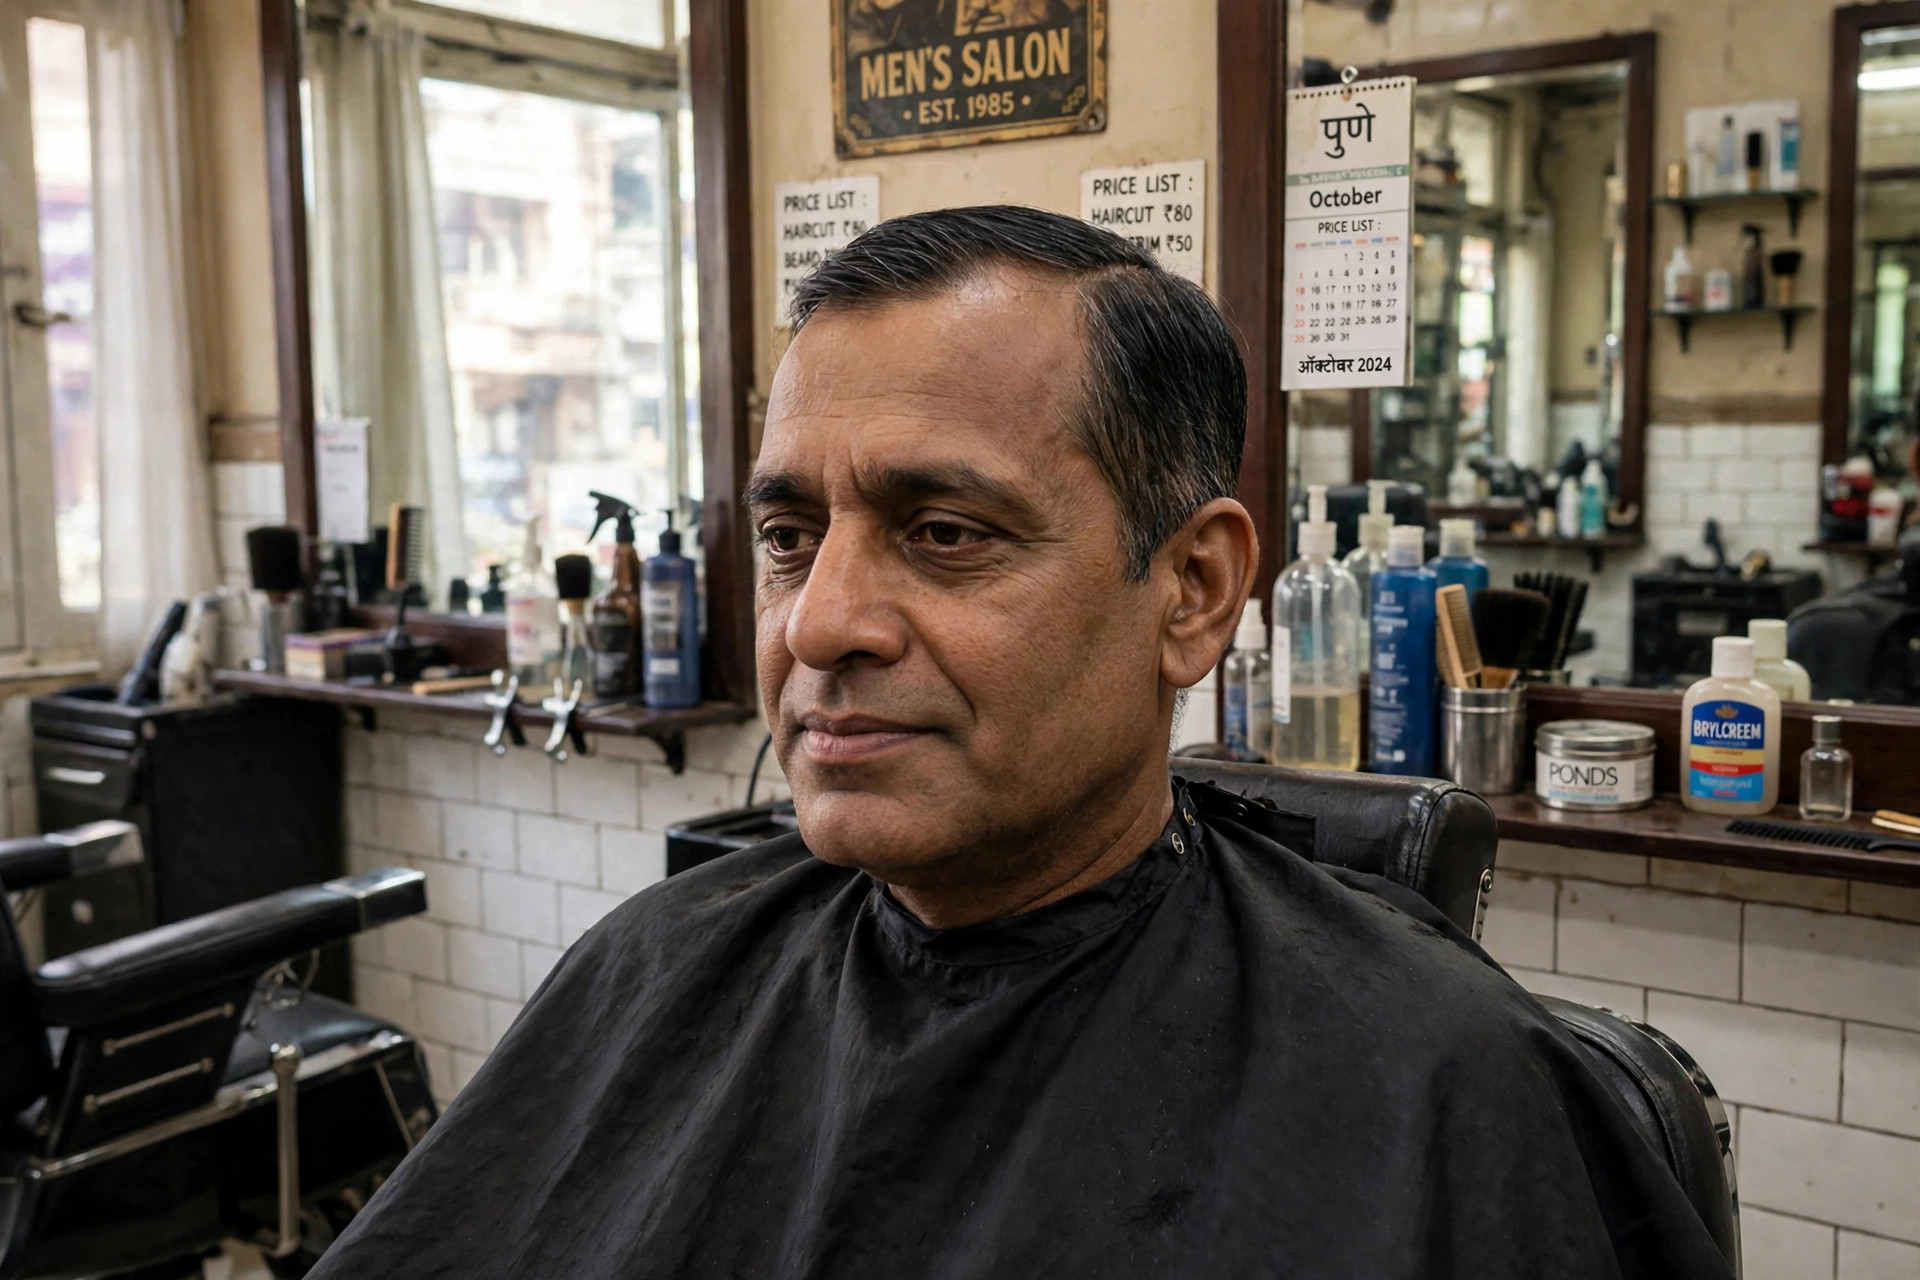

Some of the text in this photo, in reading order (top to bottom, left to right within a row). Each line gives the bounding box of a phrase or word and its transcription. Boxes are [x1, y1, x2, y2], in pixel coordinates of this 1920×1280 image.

[860, 28, 1070, 100] MEN'S SALON
[918, 91, 1015, 124] EST. 1985
[1320, 103, 1376, 159] पुणे
[1093, 176, 1137, 196] PRICE
[1146, 173, 1180, 193] LIST
[783, 193, 819, 213] PRICE
[827, 190, 855, 209] LIST
[1309, 186, 1382, 208] October
[1091, 204, 1192, 225] HAIRCUT ₹80
[783, 220, 835, 240] HAIRCUT
[1318, 221, 1347, 234] PRICE
[1352, 219, 1374, 232] LIST
[1166, 234, 1193, 253] ₹50
[1358, 356, 1392, 372] 2024
[1693, 719, 1762, 740] BRYLCREEM
[1549, 762, 1618, 786] PONDS
